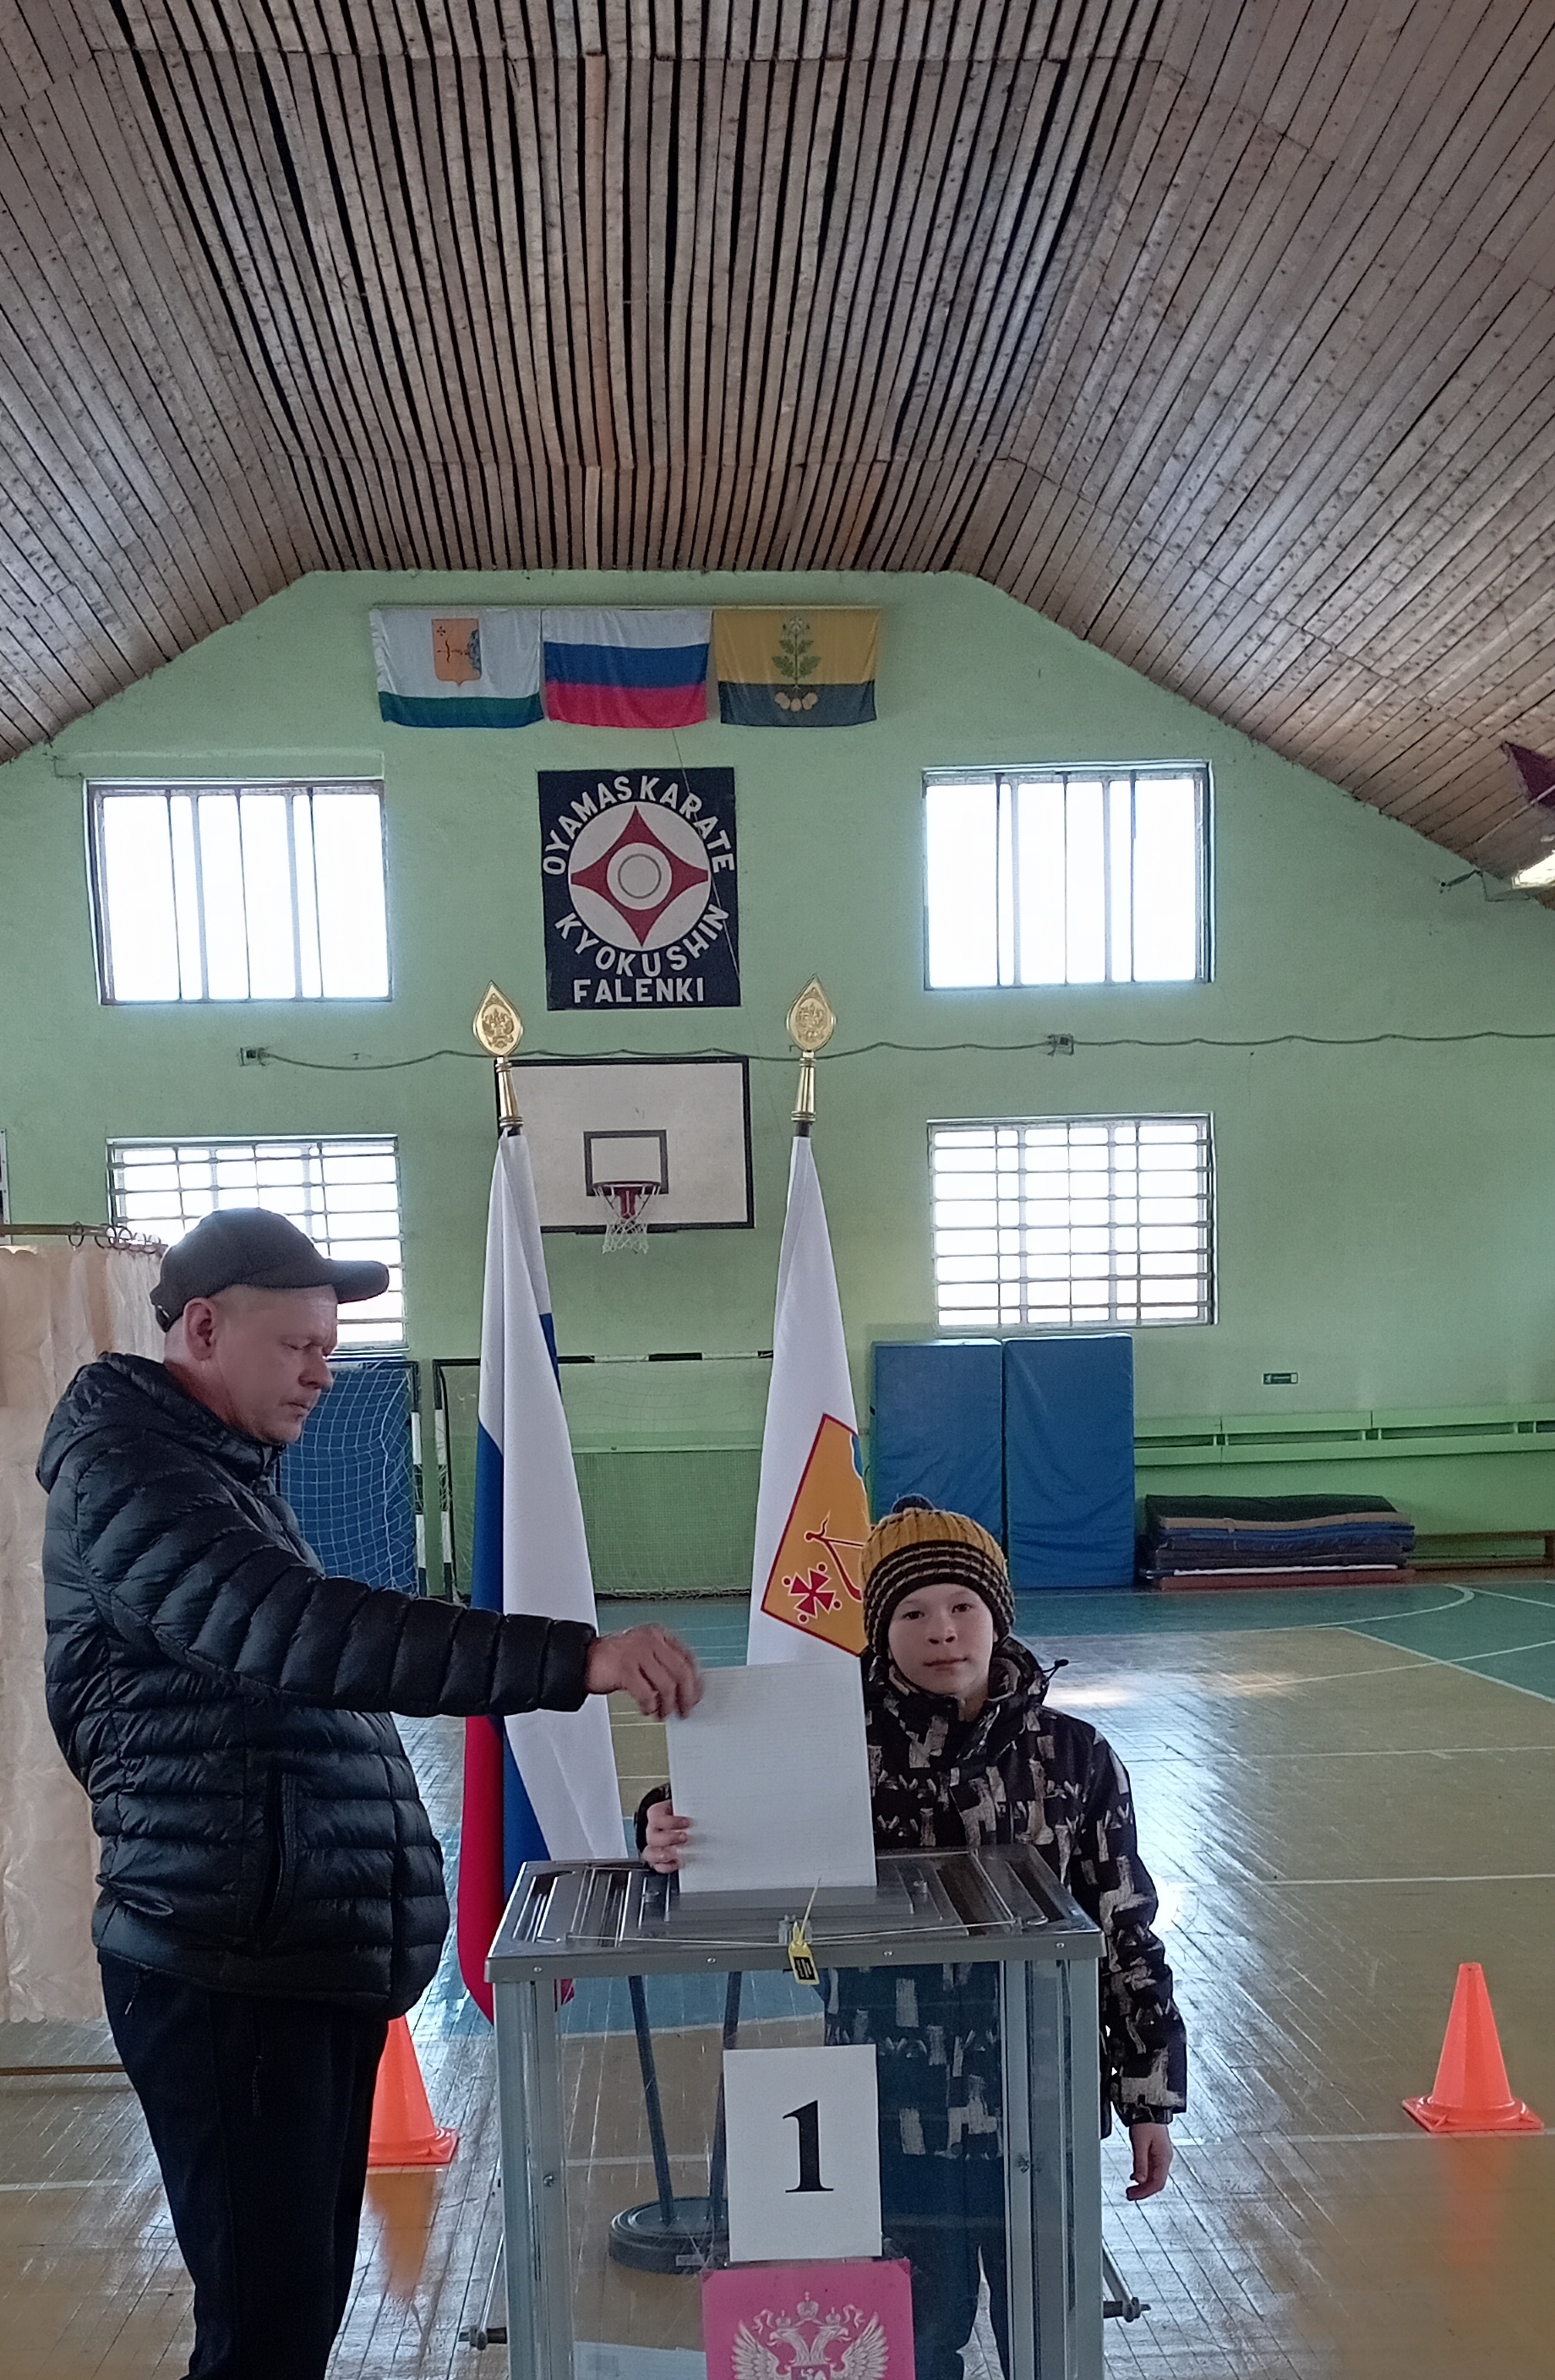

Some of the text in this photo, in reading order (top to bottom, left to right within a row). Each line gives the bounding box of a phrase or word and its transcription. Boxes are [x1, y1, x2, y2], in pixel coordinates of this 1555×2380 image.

[554, 903, 730, 977] KYOKUSHIN
[573, 977, 705, 1004] FALENKI
[782, 2099, 835, 2193] 1
